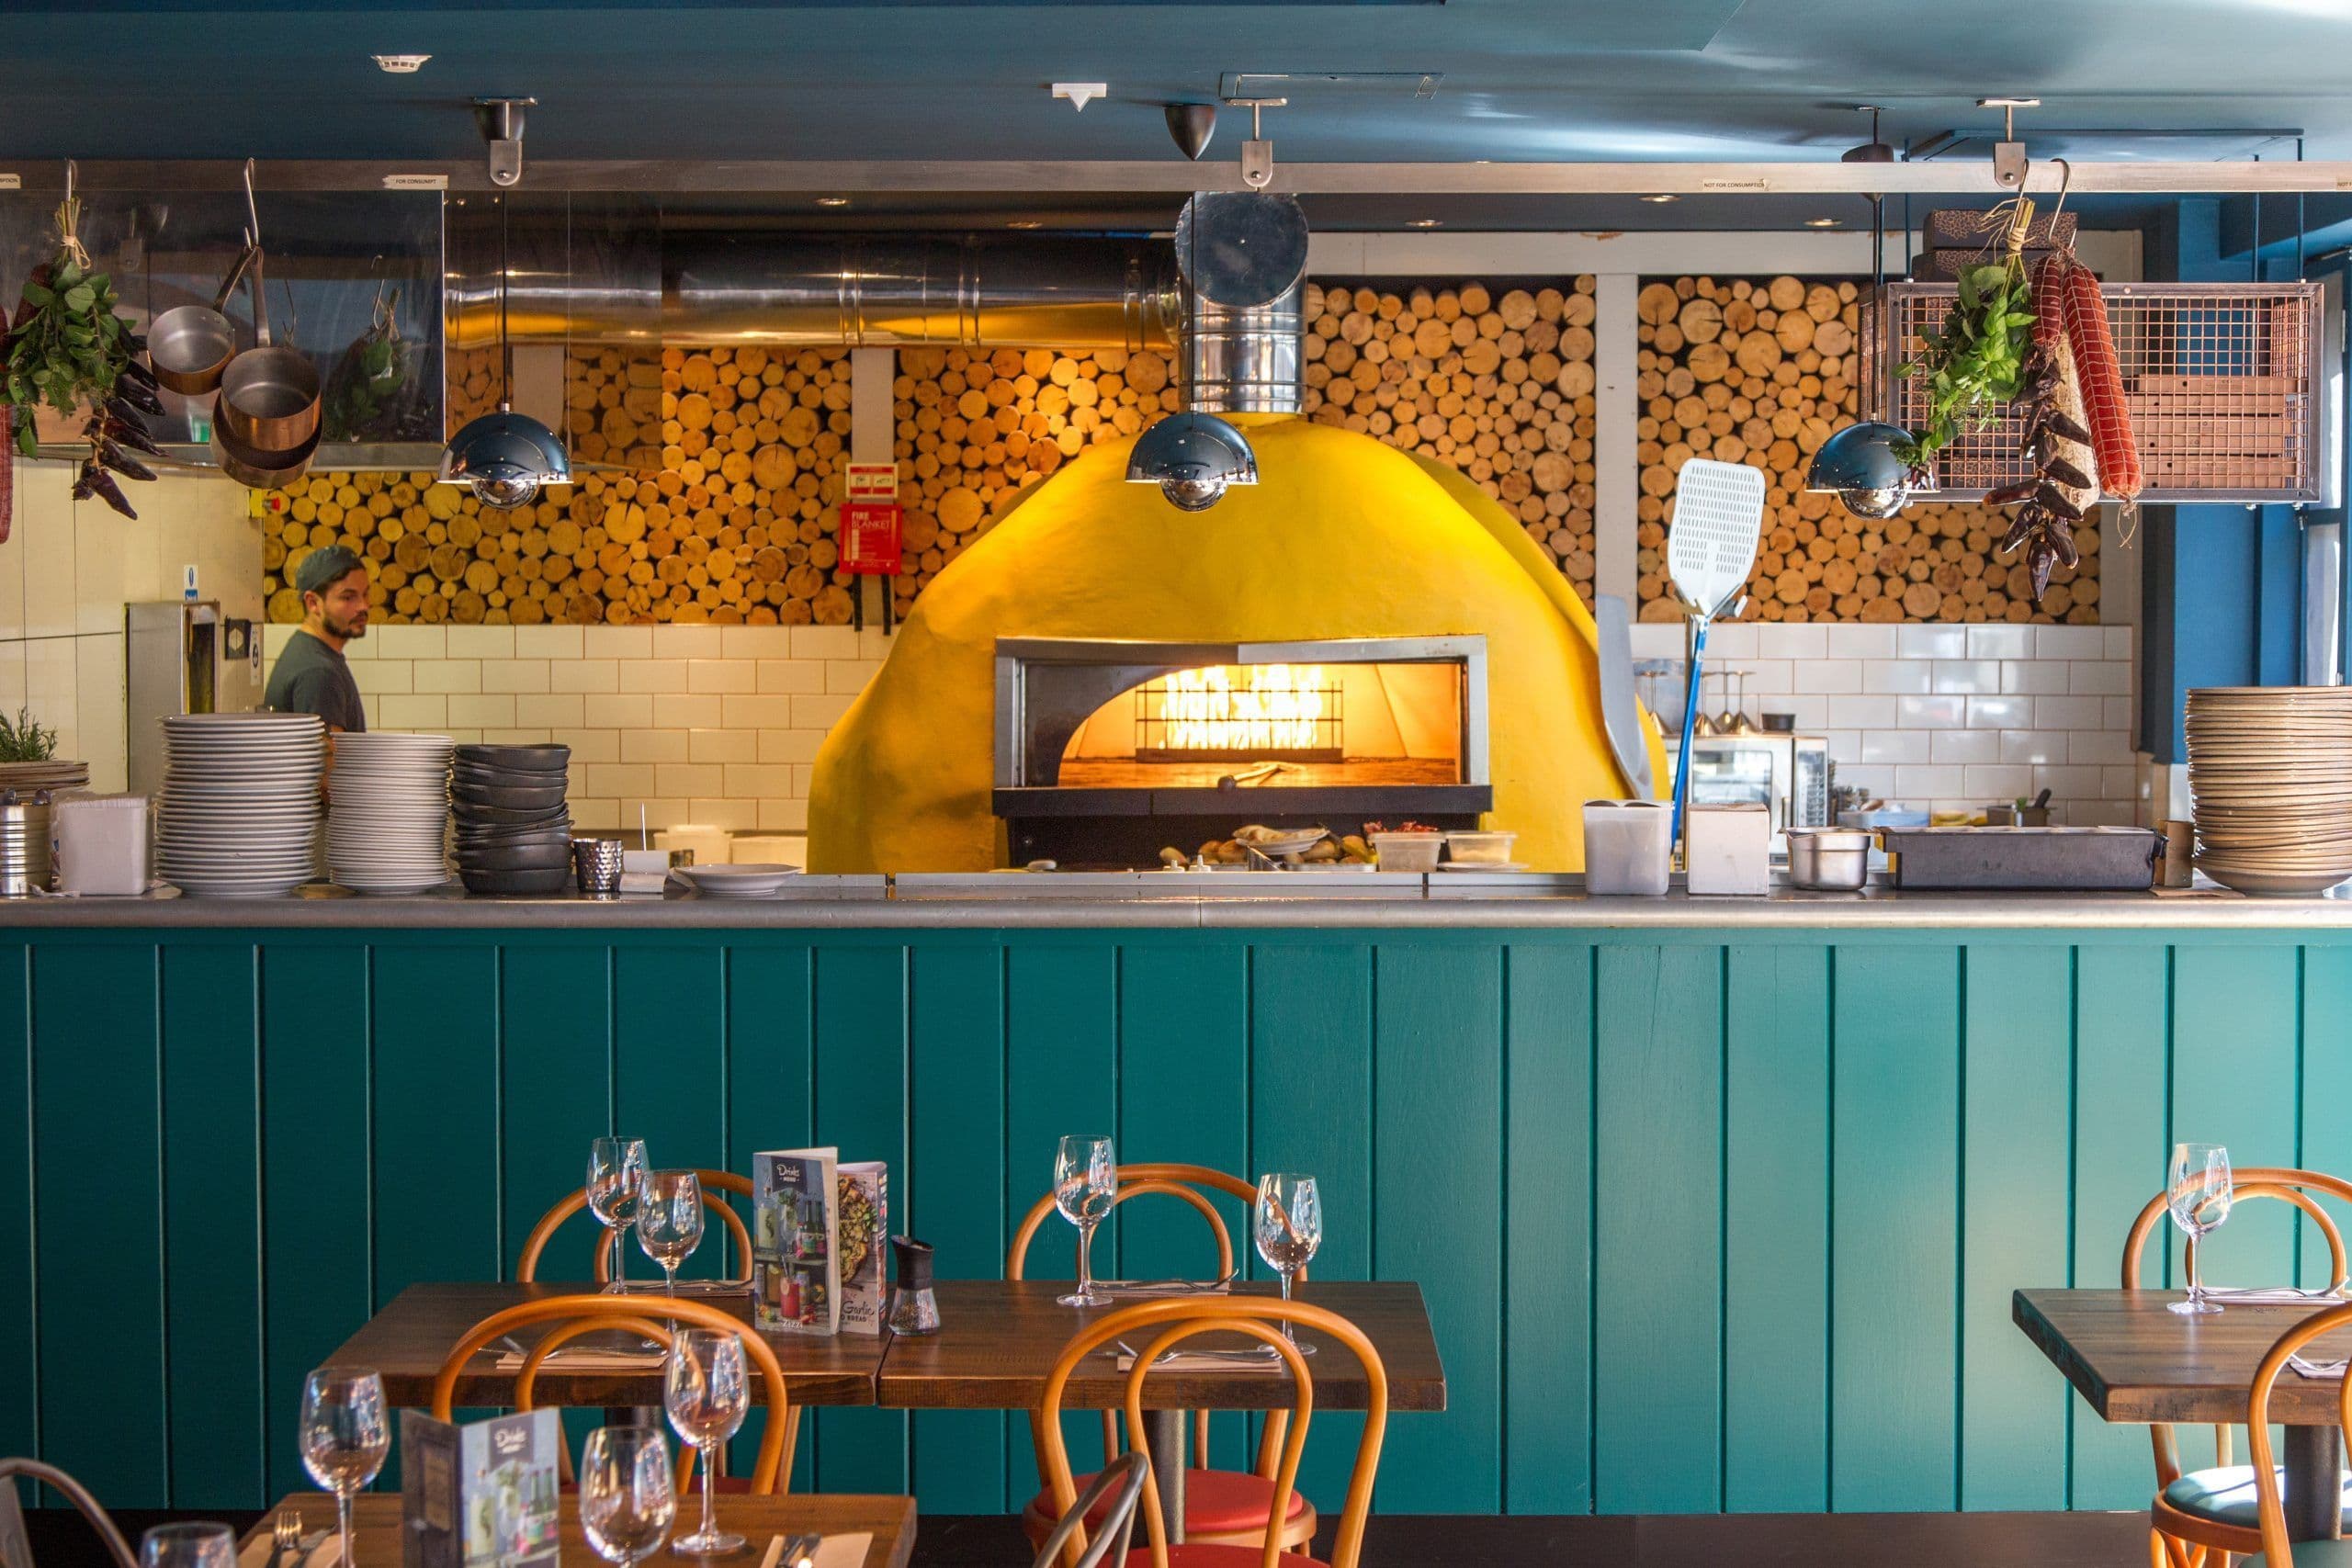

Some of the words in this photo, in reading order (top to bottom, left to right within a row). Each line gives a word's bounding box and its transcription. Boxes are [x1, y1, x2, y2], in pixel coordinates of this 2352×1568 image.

[852, 520, 890, 529] BLANKET
[776, 1164, 800, 1177] Drinks
[842, 1300, 875, 1315] Garlic
[847, 1314, 867, 1323] BREAD
